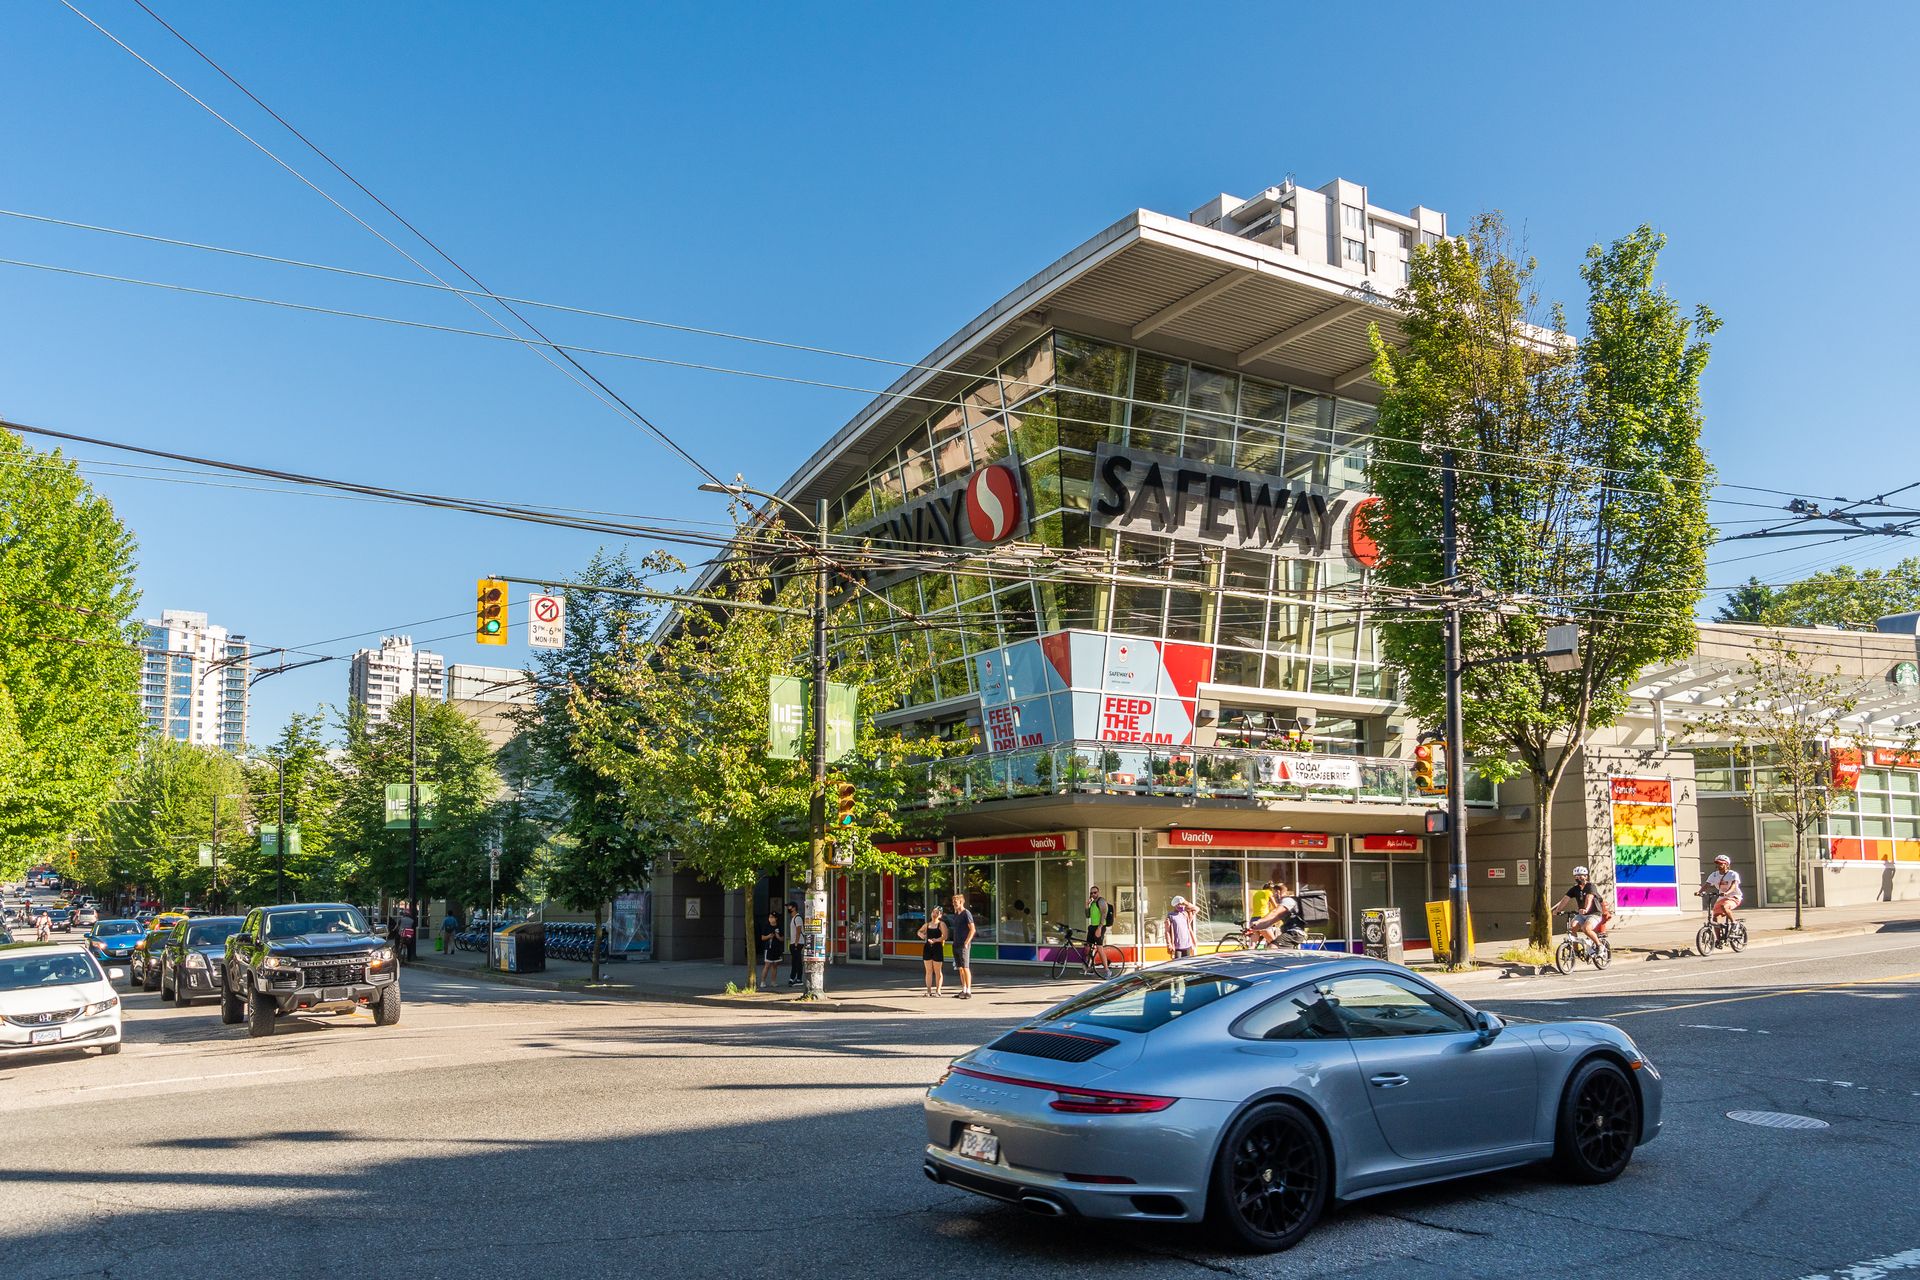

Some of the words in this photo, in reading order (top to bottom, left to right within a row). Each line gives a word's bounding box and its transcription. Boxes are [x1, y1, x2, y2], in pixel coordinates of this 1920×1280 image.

[1098, 455, 1349, 553] SAFEWAY
[1105, 697, 1152, 715] FEED
[988, 705, 1020, 725] FEED
[1103, 713, 1139, 730] THE
[781, 725, 796, 733] ARE
[991, 722, 1014, 739] THE
[1102, 729, 1172, 744] DREAM
[1295, 761, 1320, 772] LOCA
[1296, 771, 1350, 781] STRAWBERRIES
[1030, 838, 1056, 850] Vancity
[1181, 831, 1213, 843] Vancity
[1435, 922, 1444, 951] FREE
[297, 957, 371, 967] CHEVROLET
